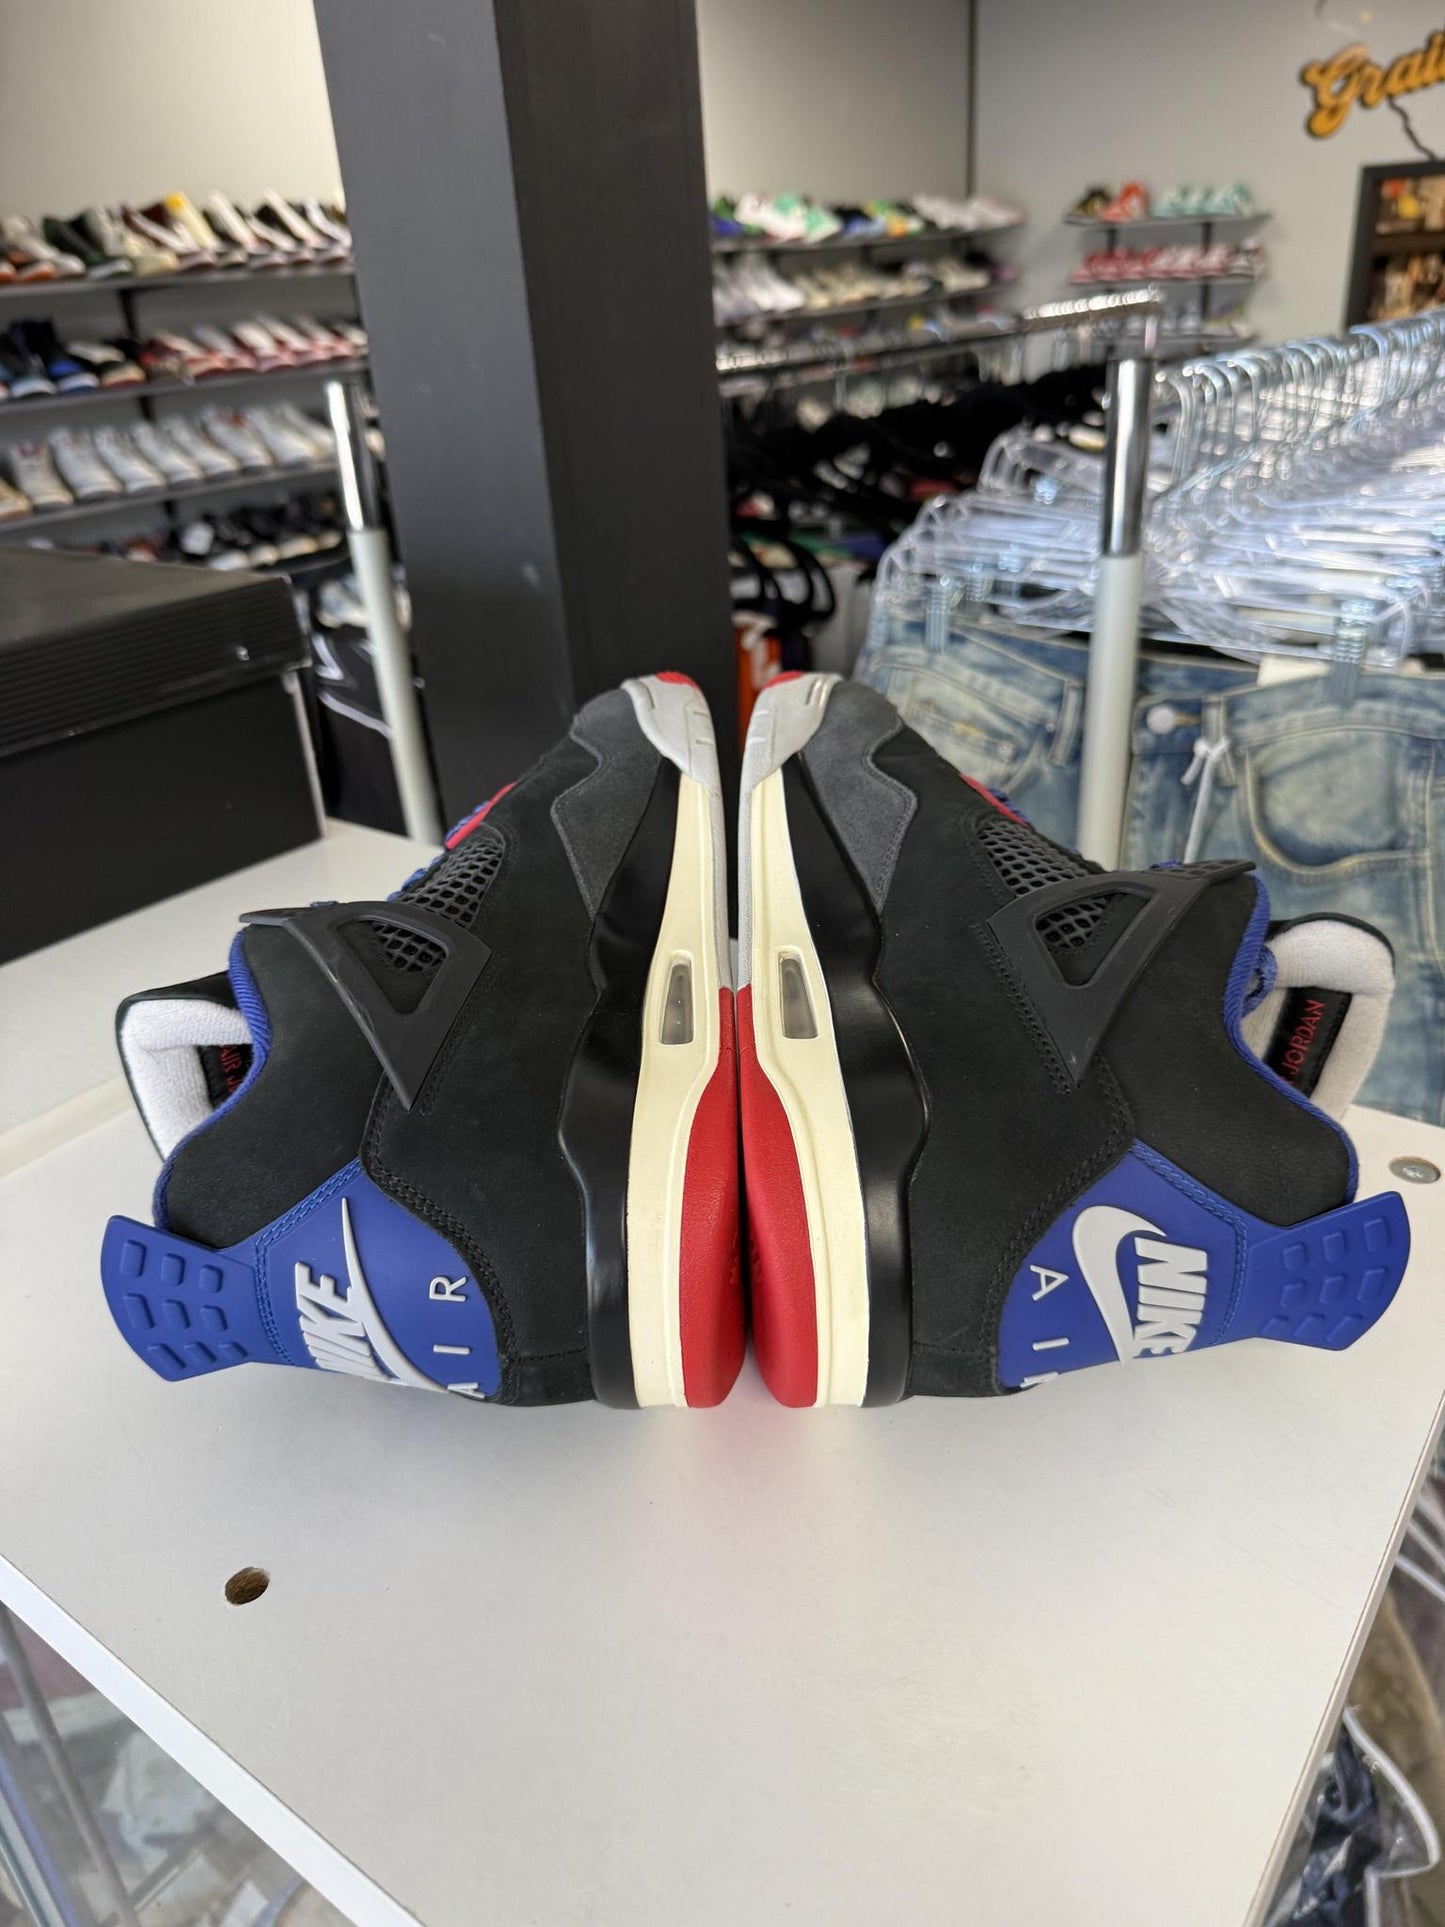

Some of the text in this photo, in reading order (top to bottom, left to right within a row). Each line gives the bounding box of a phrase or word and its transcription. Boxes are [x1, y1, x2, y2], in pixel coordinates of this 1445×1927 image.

[1299, 22, 1445, 139] Grai
[1281, 999, 1325, 1075] JORDAN
[429, 1275, 487, 1399] AIR
[1134, 1237, 1208, 1358] NIKE
